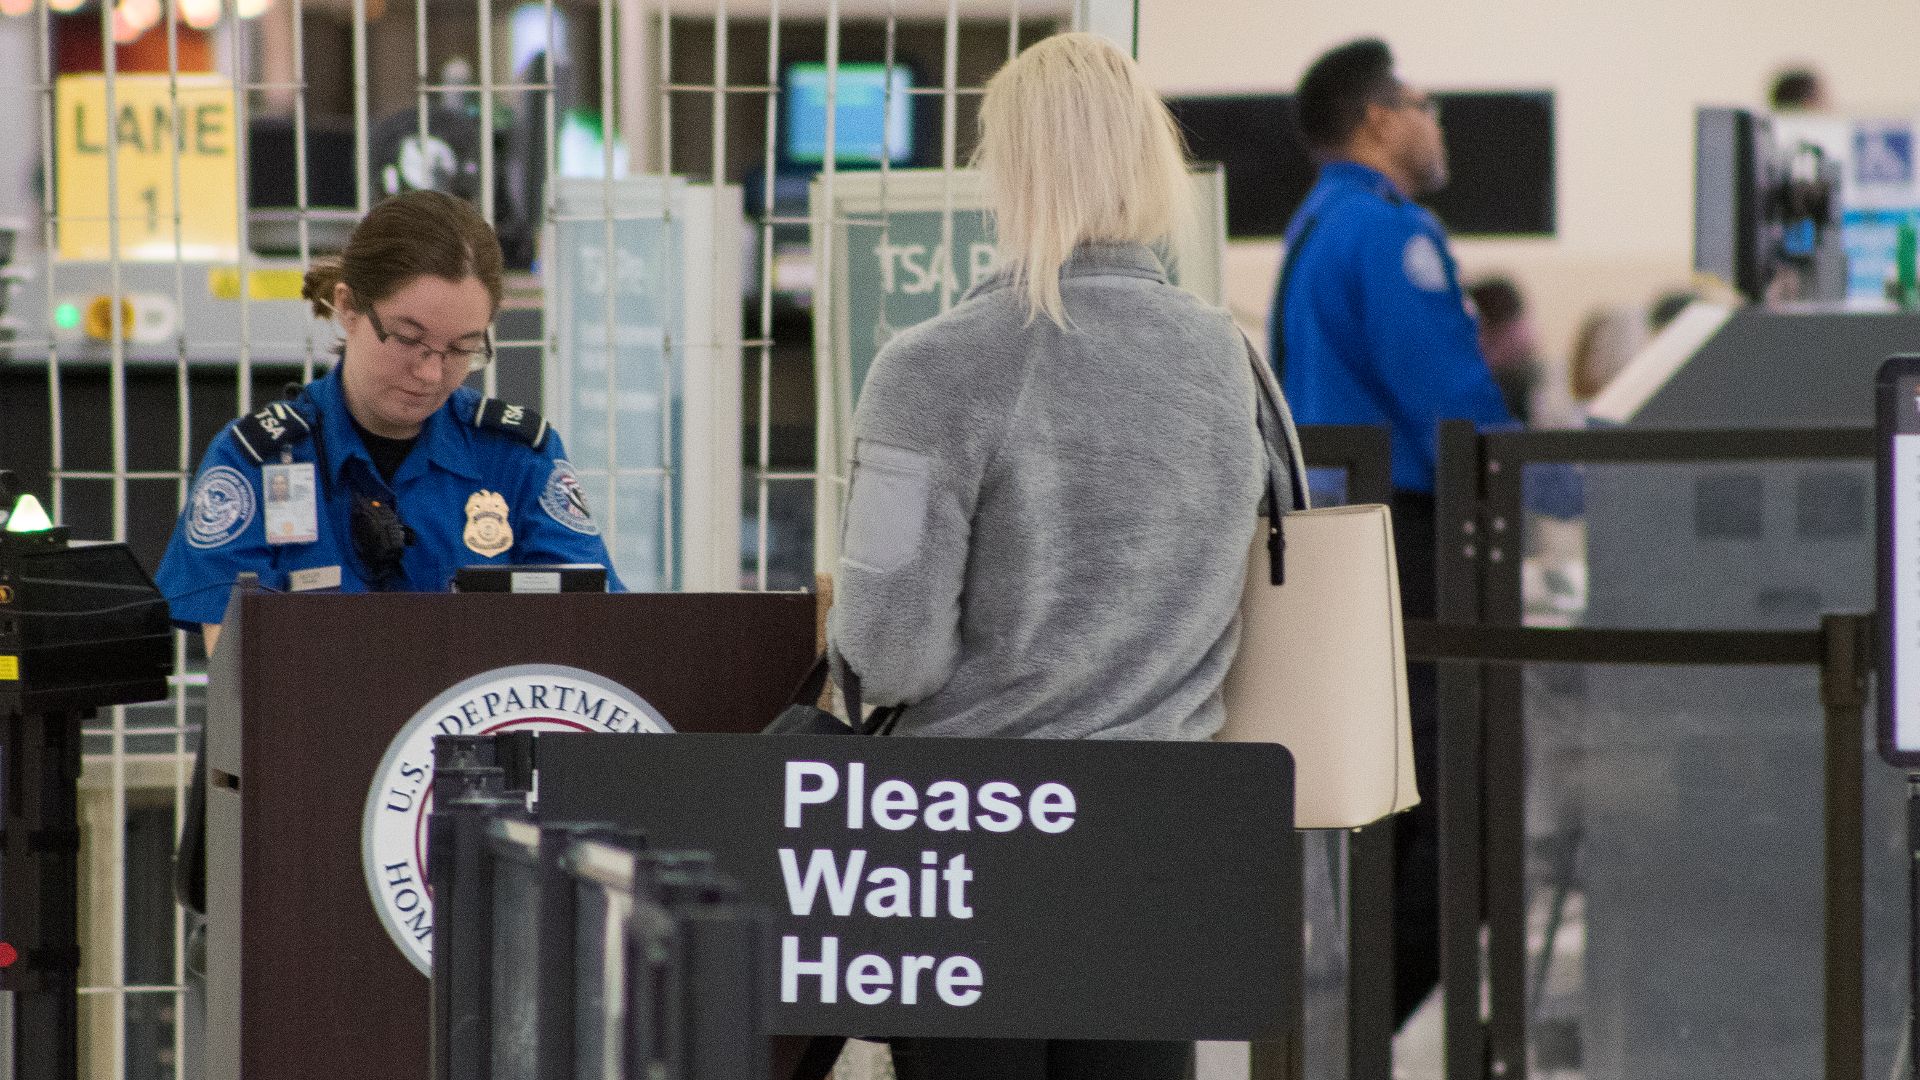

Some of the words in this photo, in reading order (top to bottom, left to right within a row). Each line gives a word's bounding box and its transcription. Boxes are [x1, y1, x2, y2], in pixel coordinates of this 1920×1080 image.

[74, 103, 226, 155] LANE
[141, 187, 158, 233] 1
[873, 243, 959, 294] TSA
[969, 243, 999, 290] P
[255, 407, 287, 441] TSA
[501, 403, 525, 426] TSA
[387, 762, 430, 813] U.S.
[784, 761, 1077, 834] Please
[778, 848, 974, 919] Wait
[780, 936, 984, 1007] Here
